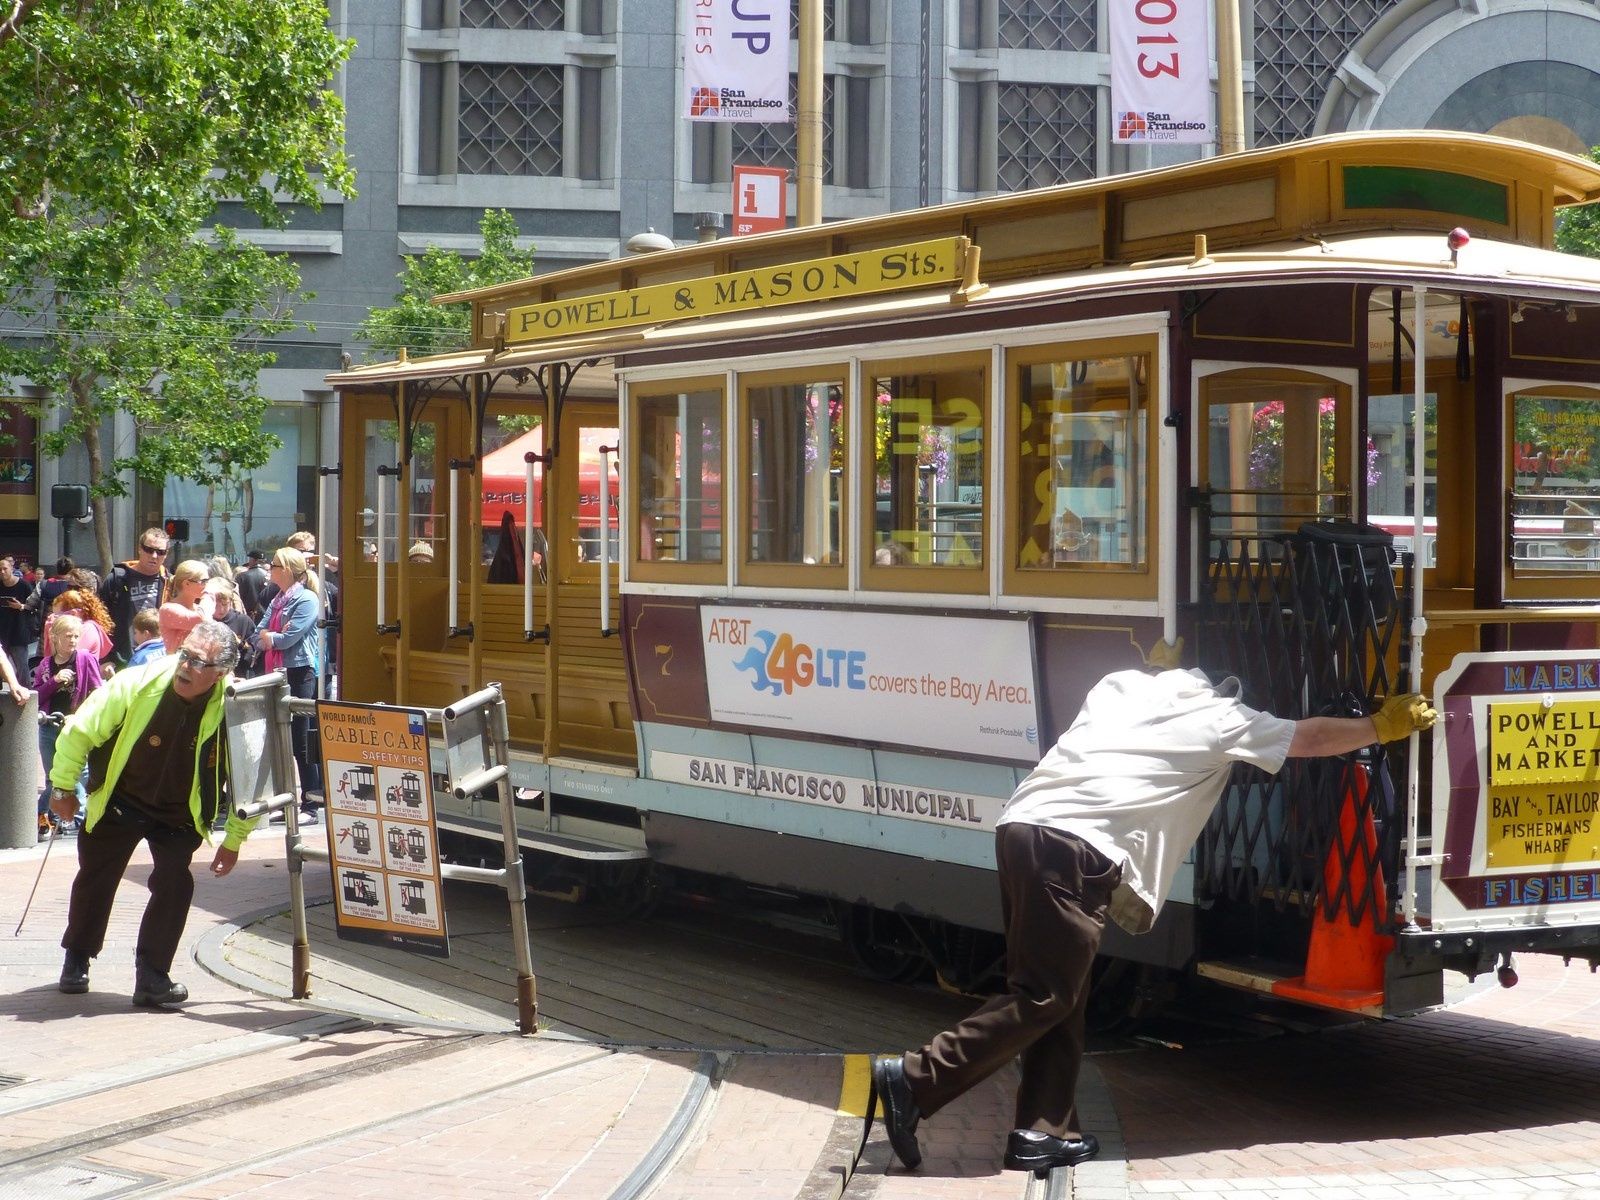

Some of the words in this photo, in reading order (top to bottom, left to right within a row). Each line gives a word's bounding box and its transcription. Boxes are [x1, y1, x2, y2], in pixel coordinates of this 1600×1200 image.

[720, 87, 746, 97] San
[720, 98, 783, 108] Francisco
[720, 107, 753, 117] Travel
[1146, 111, 1171, 121] San
[1147, 121, 1206, 130] Francisco
[1148, 130, 1178, 140] Travel
[738, 224, 752, 232] SF
[520, 295, 650, 333] POWELL
[674, 287, 696, 311] &
[714, 260, 860, 305] MASON
[880, 251, 945, 282] Sts.
[708, 618, 752, 645] AT&T
[655, 643, 675, 676] 7
[1504, 662, 1600, 692] MARK
[869, 674, 917, 695] covers
[920, 673, 947, 697] the
[950, 676, 982, 706] Bay
[985, 679, 1032, 705] Area.
[322, 711, 346, 722] WORLD
[347, 715, 376, 726] FAMOUS
[1498, 711, 1600, 733] POWELL
[324, 725, 379, 746] CABLE
[383, 731, 422, 750] CAR
[1526, 733, 1577, 749] AND
[362, 750, 400, 763] SAFETY
[402, 755, 424, 766] TIPS
[1496, 748, 1600, 771] MARKET
[689, 759, 727, 785] SAN
[733, 766, 846, 804] FRANCISCO
[1493, 796, 1520, 818] BAY
[1526, 797, 1542, 816] AND
[1547, 791, 1600, 815] TAYLOR
[1502, 819, 1591, 839] FISHERMANS
[1524, 838, 1570, 855] WHARF
